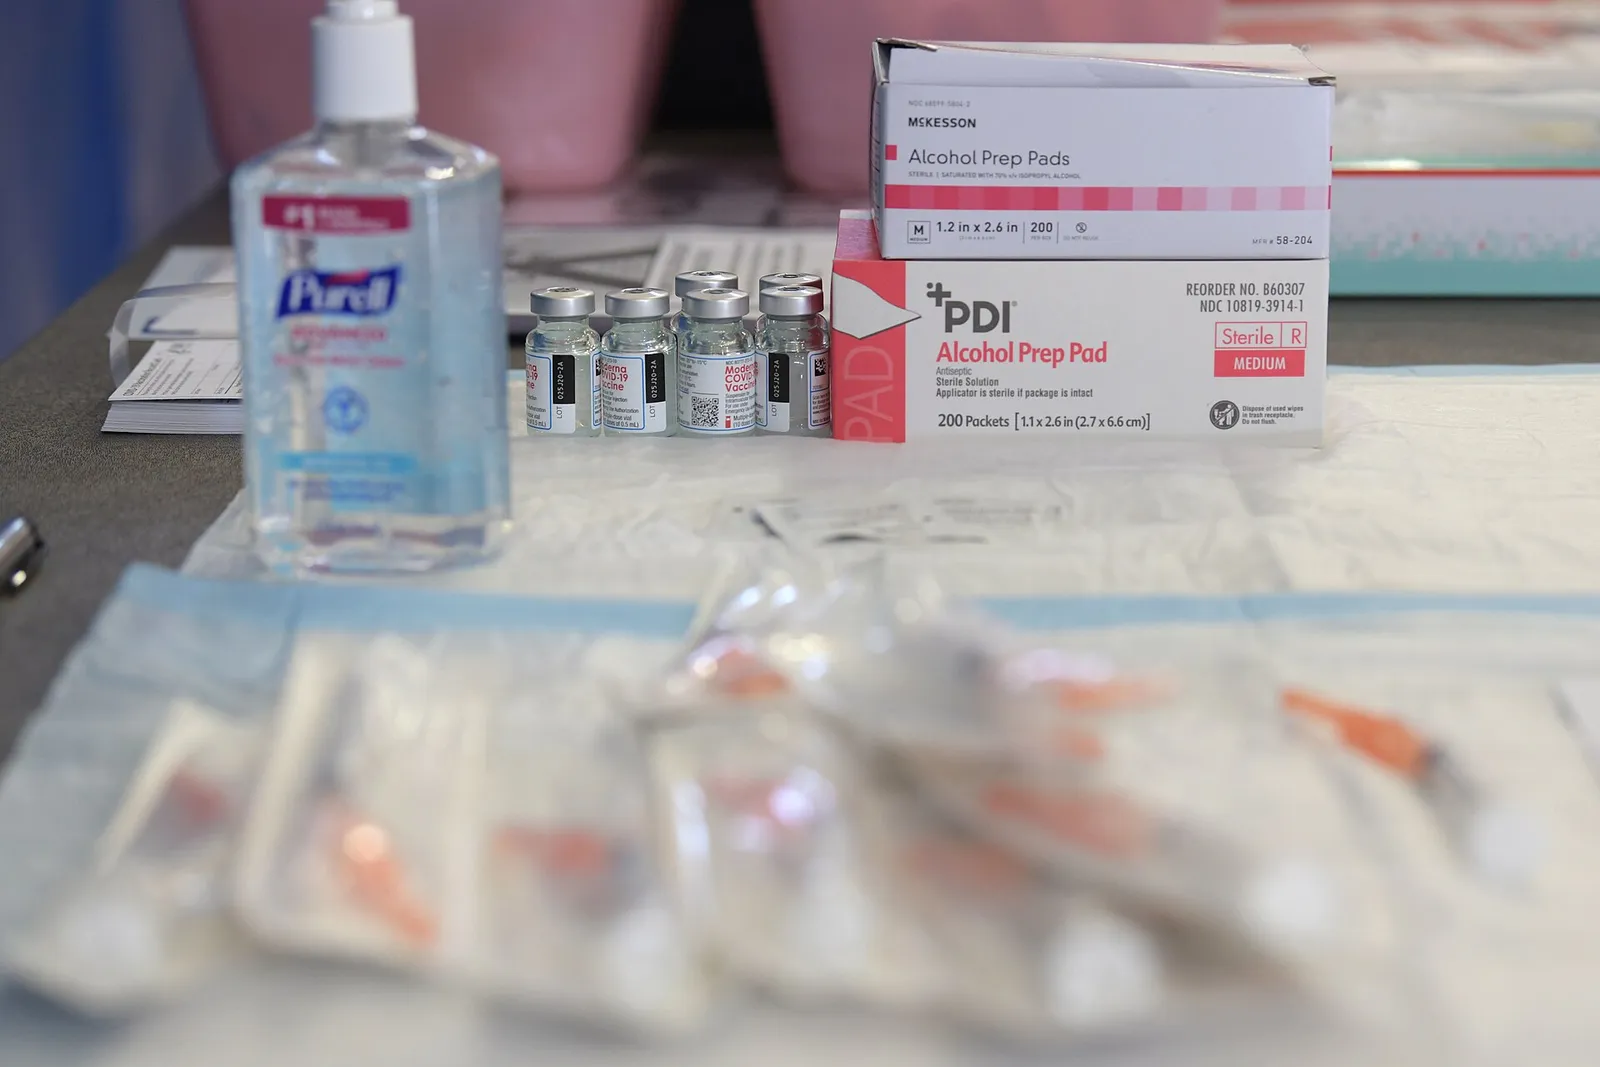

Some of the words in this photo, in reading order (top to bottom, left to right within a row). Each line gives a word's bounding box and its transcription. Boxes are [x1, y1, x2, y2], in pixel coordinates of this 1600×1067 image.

[908, 149, 977, 165] Alcohol
[982, 150, 1022, 169] Prep
[1028, 150, 1070, 166] Pads
[914, 224, 924, 235] M
[936, 222, 954, 232] 1.2
[958, 222, 970, 232] in
[974, 224, 980, 232] x
[984, 222, 1003, 233] 2.6
[1006, 222, 1018, 232] in
[1030, 222, 1053, 232] 200
[1276, 236, 1312, 244] 58-204
[1186, 283, 1236, 296] REORDER
[1240, 283, 1259, 296] NO.
[1263, 282, 1305, 296] B60307
[1200, 300, 1222, 312] NDC
[1227, 300, 1303, 312] 10819-3914-1
[945, 300, 1010, 333] PDI
[1222, 326, 1274, 345] Sterile
[1292, 328, 1302, 344] R
[936, 340, 1014, 362] Alcohol
[1019, 342, 1064, 368] Prep
[1070, 341, 1107, 362] Pad
[1233, 357, 1286, 370] MEDIUM
[936, 367, 972, 376] Antiseptic
[936, 377, 963, 387] Sterile
[966, 377, 999, 387] Solution
[843, 346, 894, 442] PAD
[936, 388, 977, 399] Applicator
[980, 388, 987, 397] is
[989, 388, 1015, 398] sterile
[1017, 388, 1023, 397] if
[1025, 388, 1058, 399] package
[1061, 388, 1068, 397] is
[1070, 388, 1093, 398] intact
[938, 414, 963, 427] 200
[966, 415, 1009, 427] Packets
[1036, 418, 1043, 427] x
[1045, 416, 1062, 427] 2.6
[1064, 416, 1073, 427] in
[1075, 416, 1096, 430] (2.7
[1098, 418, 1105, 427] x
[1107, 416, 1124, 427] 6.6
[1126, 413, 1150, 430] cm)]
